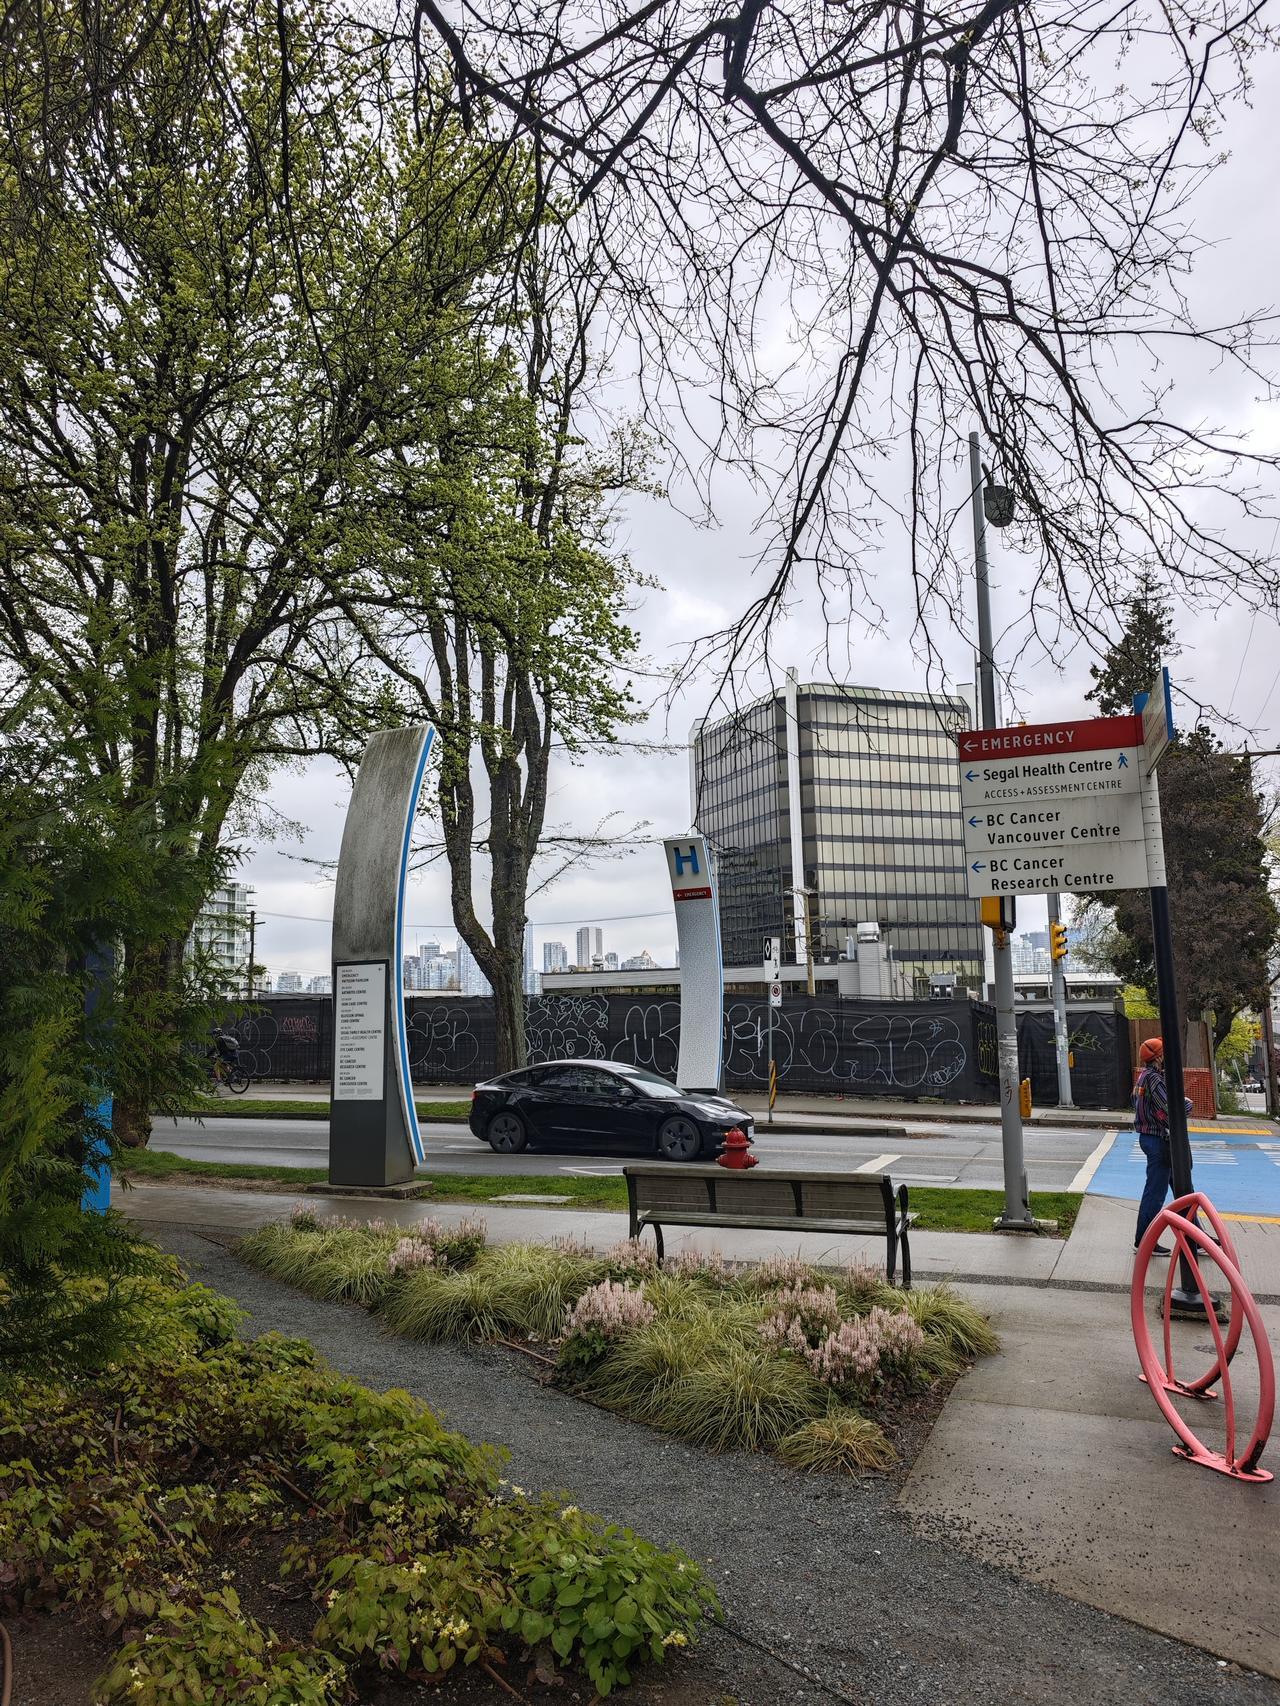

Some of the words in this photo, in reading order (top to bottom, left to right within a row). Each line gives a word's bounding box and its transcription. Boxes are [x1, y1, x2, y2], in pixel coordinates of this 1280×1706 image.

[981, 730, 1075, 751] EMERGENCY
[983, 766, 1019, 782] Segal
[1022, 762, 1065, 778] Health
[1069, 759, 1112, 774] Centre
[984, 788, 1018, 799] ACCESS
[1026, 783, 1085, 795] ASSESSMENT
[1087, 780, 1122, 790] CENTRE
[986, 814, 1005, 826] BC
[1010, 811, 1060, 824] Cancer
[988, 828, 1065, 845] Vancouver
[1071, 824, 1120, 839] Centre
[673, 845, 699, 875] H
[990, 860, 1008, 872] BC
[1013, 856, 1064, 871] Cancer
[991, 875, 1058, 890] Research
[1064, 872, 1114, 886] Centre
